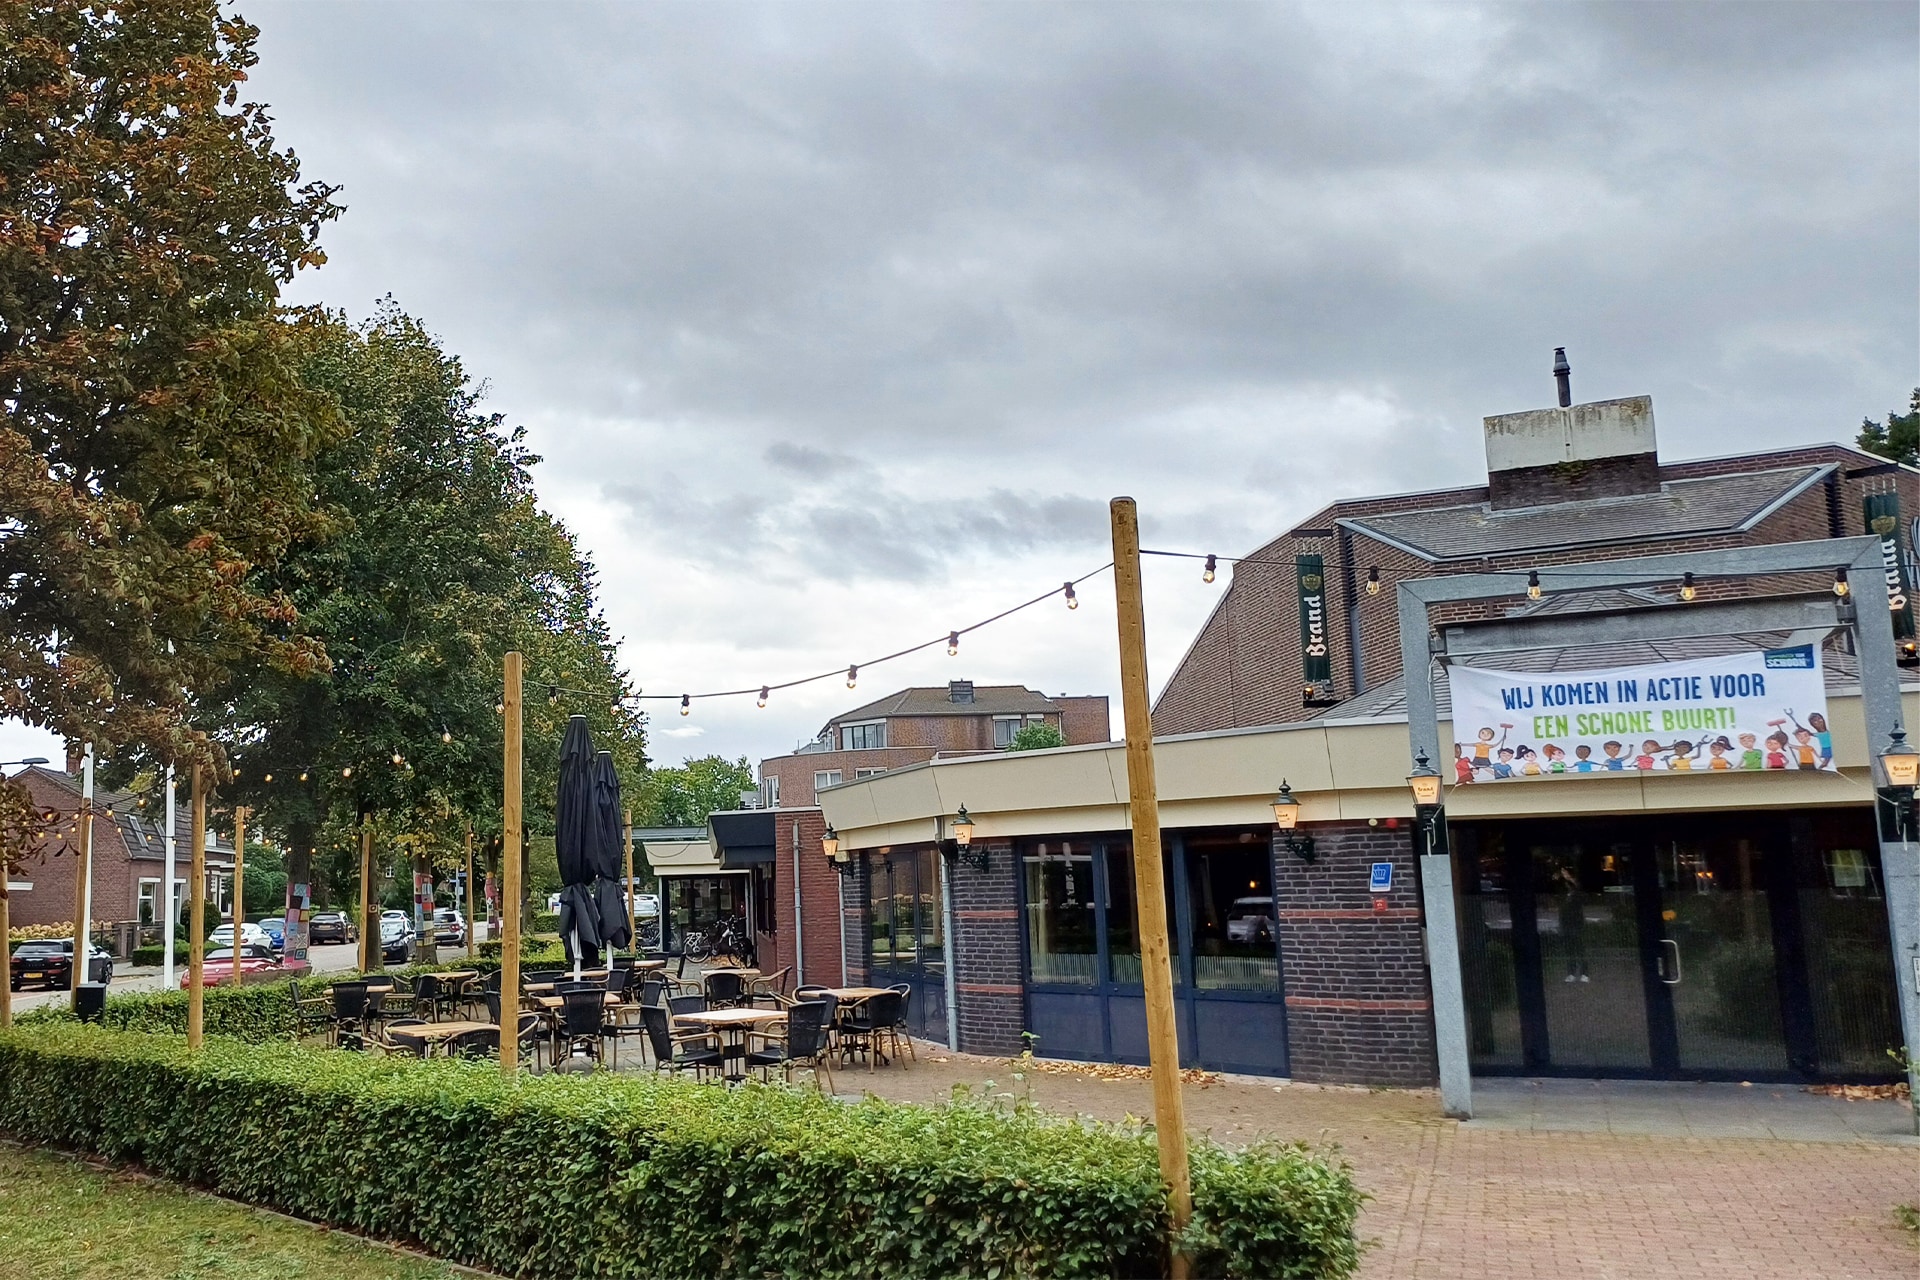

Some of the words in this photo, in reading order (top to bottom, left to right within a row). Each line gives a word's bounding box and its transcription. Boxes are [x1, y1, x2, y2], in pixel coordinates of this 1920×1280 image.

[1304, 594, 1327, 657] Brand
[1501, 686, 1534, 710] WIJ
[1542, 681, 1609, 707] KOMEN
[1617, 679, 1638, 703] IN
[1646, 676, 1703, 702] ACTIE
[1709, 673, 1766, 699] VOOR
[1533, 715, 1569, 739] EEN
[1576, 710, 1655, 736] SCHONE
[1661, 706, 1736, 732] BUURT!
